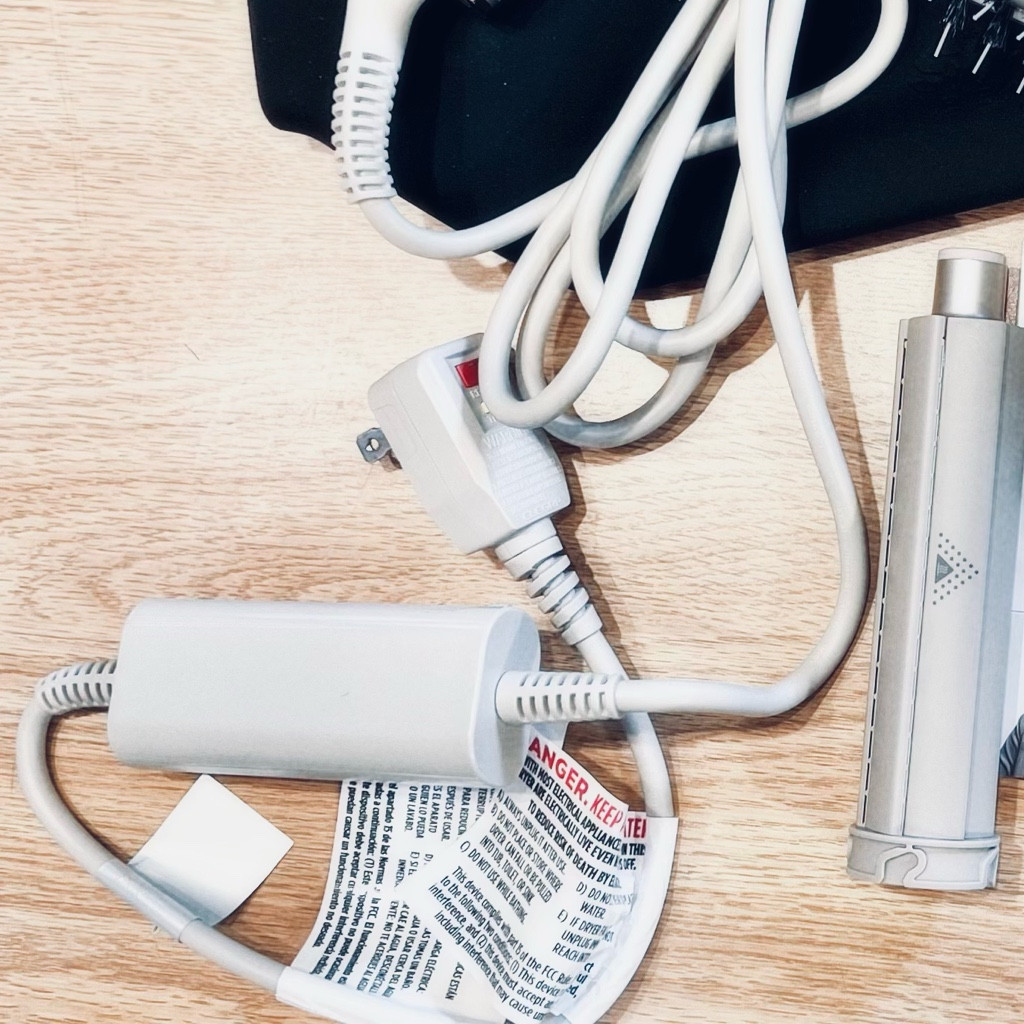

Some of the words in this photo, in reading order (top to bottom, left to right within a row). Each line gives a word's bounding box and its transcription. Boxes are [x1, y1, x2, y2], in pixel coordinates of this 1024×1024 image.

[528, 736, 588, 805] ANGER.
[347, 786, 356, 814] puedan
[385, 790, 395, 823] apartado
[420, 785, 430, 805] GUIEN
[445, 786, 457, 810] ESPUÉS
[462, 787, 472, 805] PARA
[552, 783, 582, 822] ELECTRICAL
[343, 816, 352, 839] causar
[416, 816, 426, 838] PUEDA
[429, 802, 440, 833] APARATO
[544, 794, 580, 838] ELECTRICALLY
[577, 832, 593, 853] LIVE
[355, 832, 365, 849] debe
[380, 845, 390, 855] las
[480, 835, 495, 853] INTO
[512, 829, 527, 850] PLACE
[535, 808, 559, 837] REDUCE
[572, 853, 599, 880] DEATH
[542, 841, 560, 863] AFTER
[350, 851, 361, 878] aceptar
[376, 856, 388, 884] Normas
[362, 870, 373, 885] Este
[476, 857, 491, 873] NOT
[487, 868, 500, 884] USE
[496, 878, 513, 901] WHILE
[535, 879, 552, 903] PULLED
[398, 910, 409, 923] CAE
[452, 866, 467, 884] This
[464, 881, 483, 902] device
[526, 957, 542, 972] the
[541, 965, 558, 981] FCC
[402, 936, 415, 953] USAR
[448, 883, 461, 898] the
[459, 894, 486, 927] following
[518, 967, 535, 985] This
[394, 954, 408, 972] CERCA
[435, 911, 465, 945] including
[509, 998, 533, 1016] cause
[465, 924, 481, 939] and
[517, 987, 546, 1006] accept
